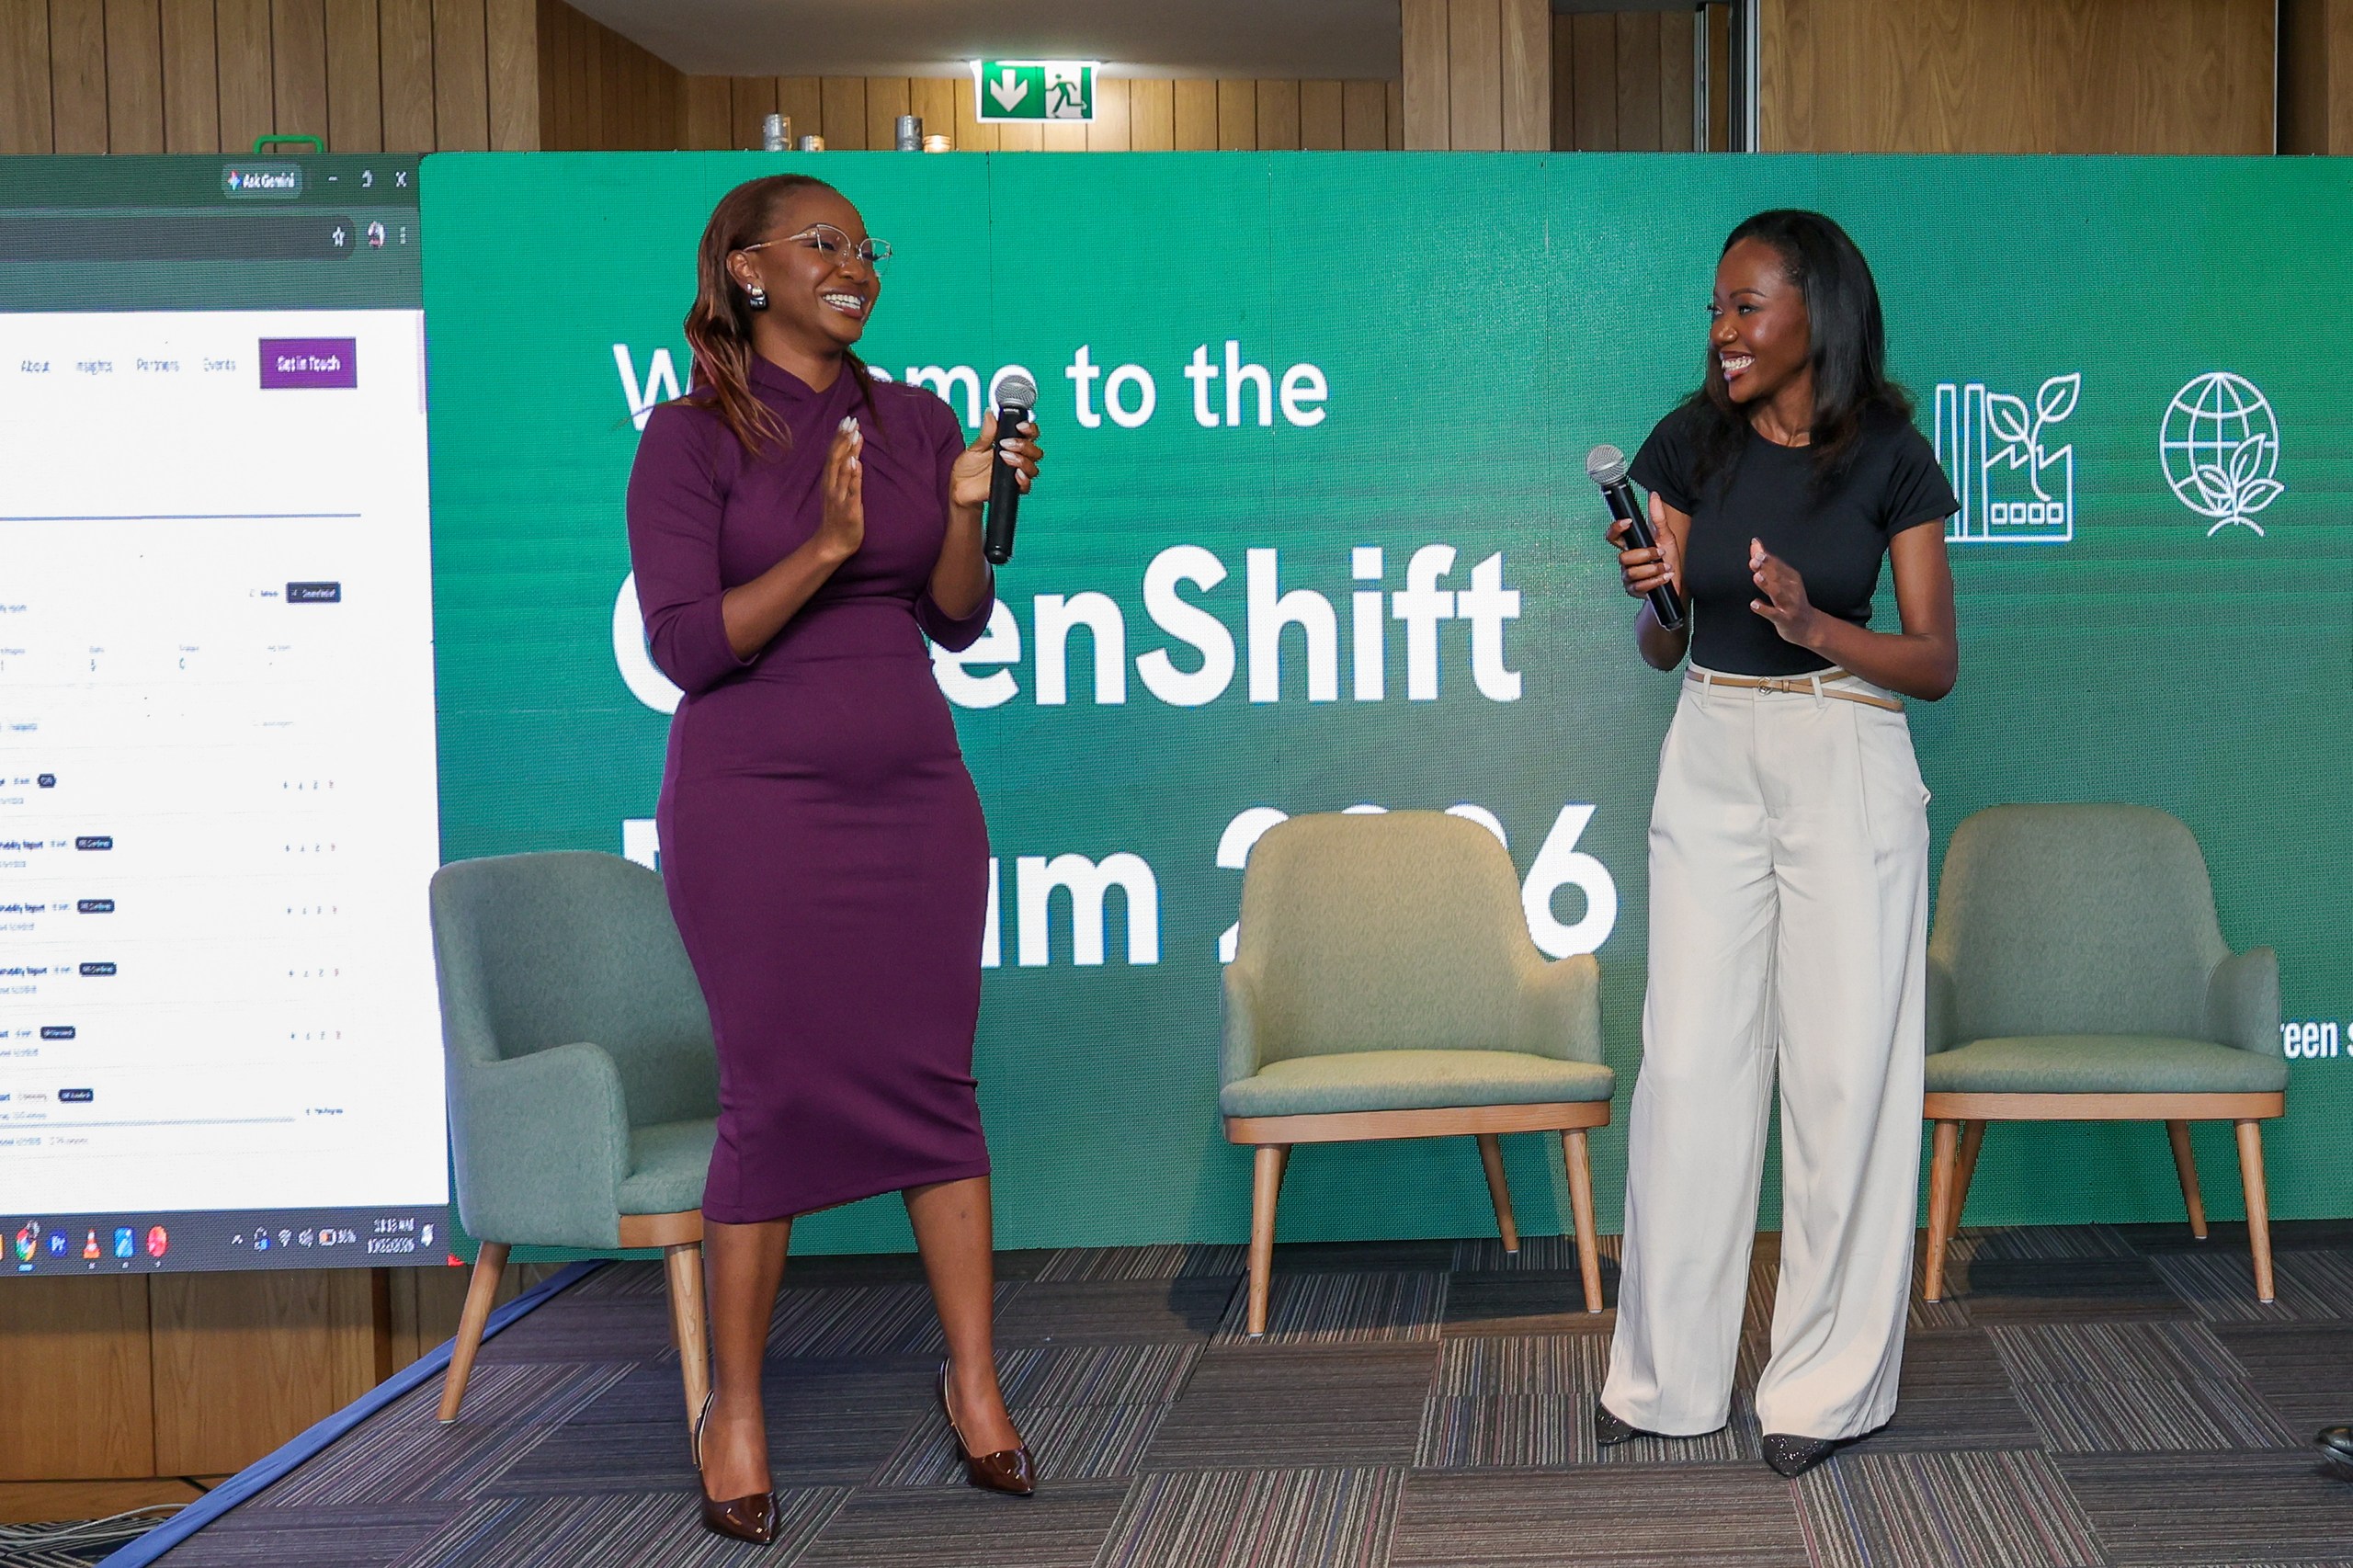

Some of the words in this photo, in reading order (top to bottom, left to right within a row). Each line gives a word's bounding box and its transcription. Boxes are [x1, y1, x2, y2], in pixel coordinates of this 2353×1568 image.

[1066, 345, 1156, 428] to
[1185, 340, 1328, 427] the
[613, 544, 1523, 715] enShift
